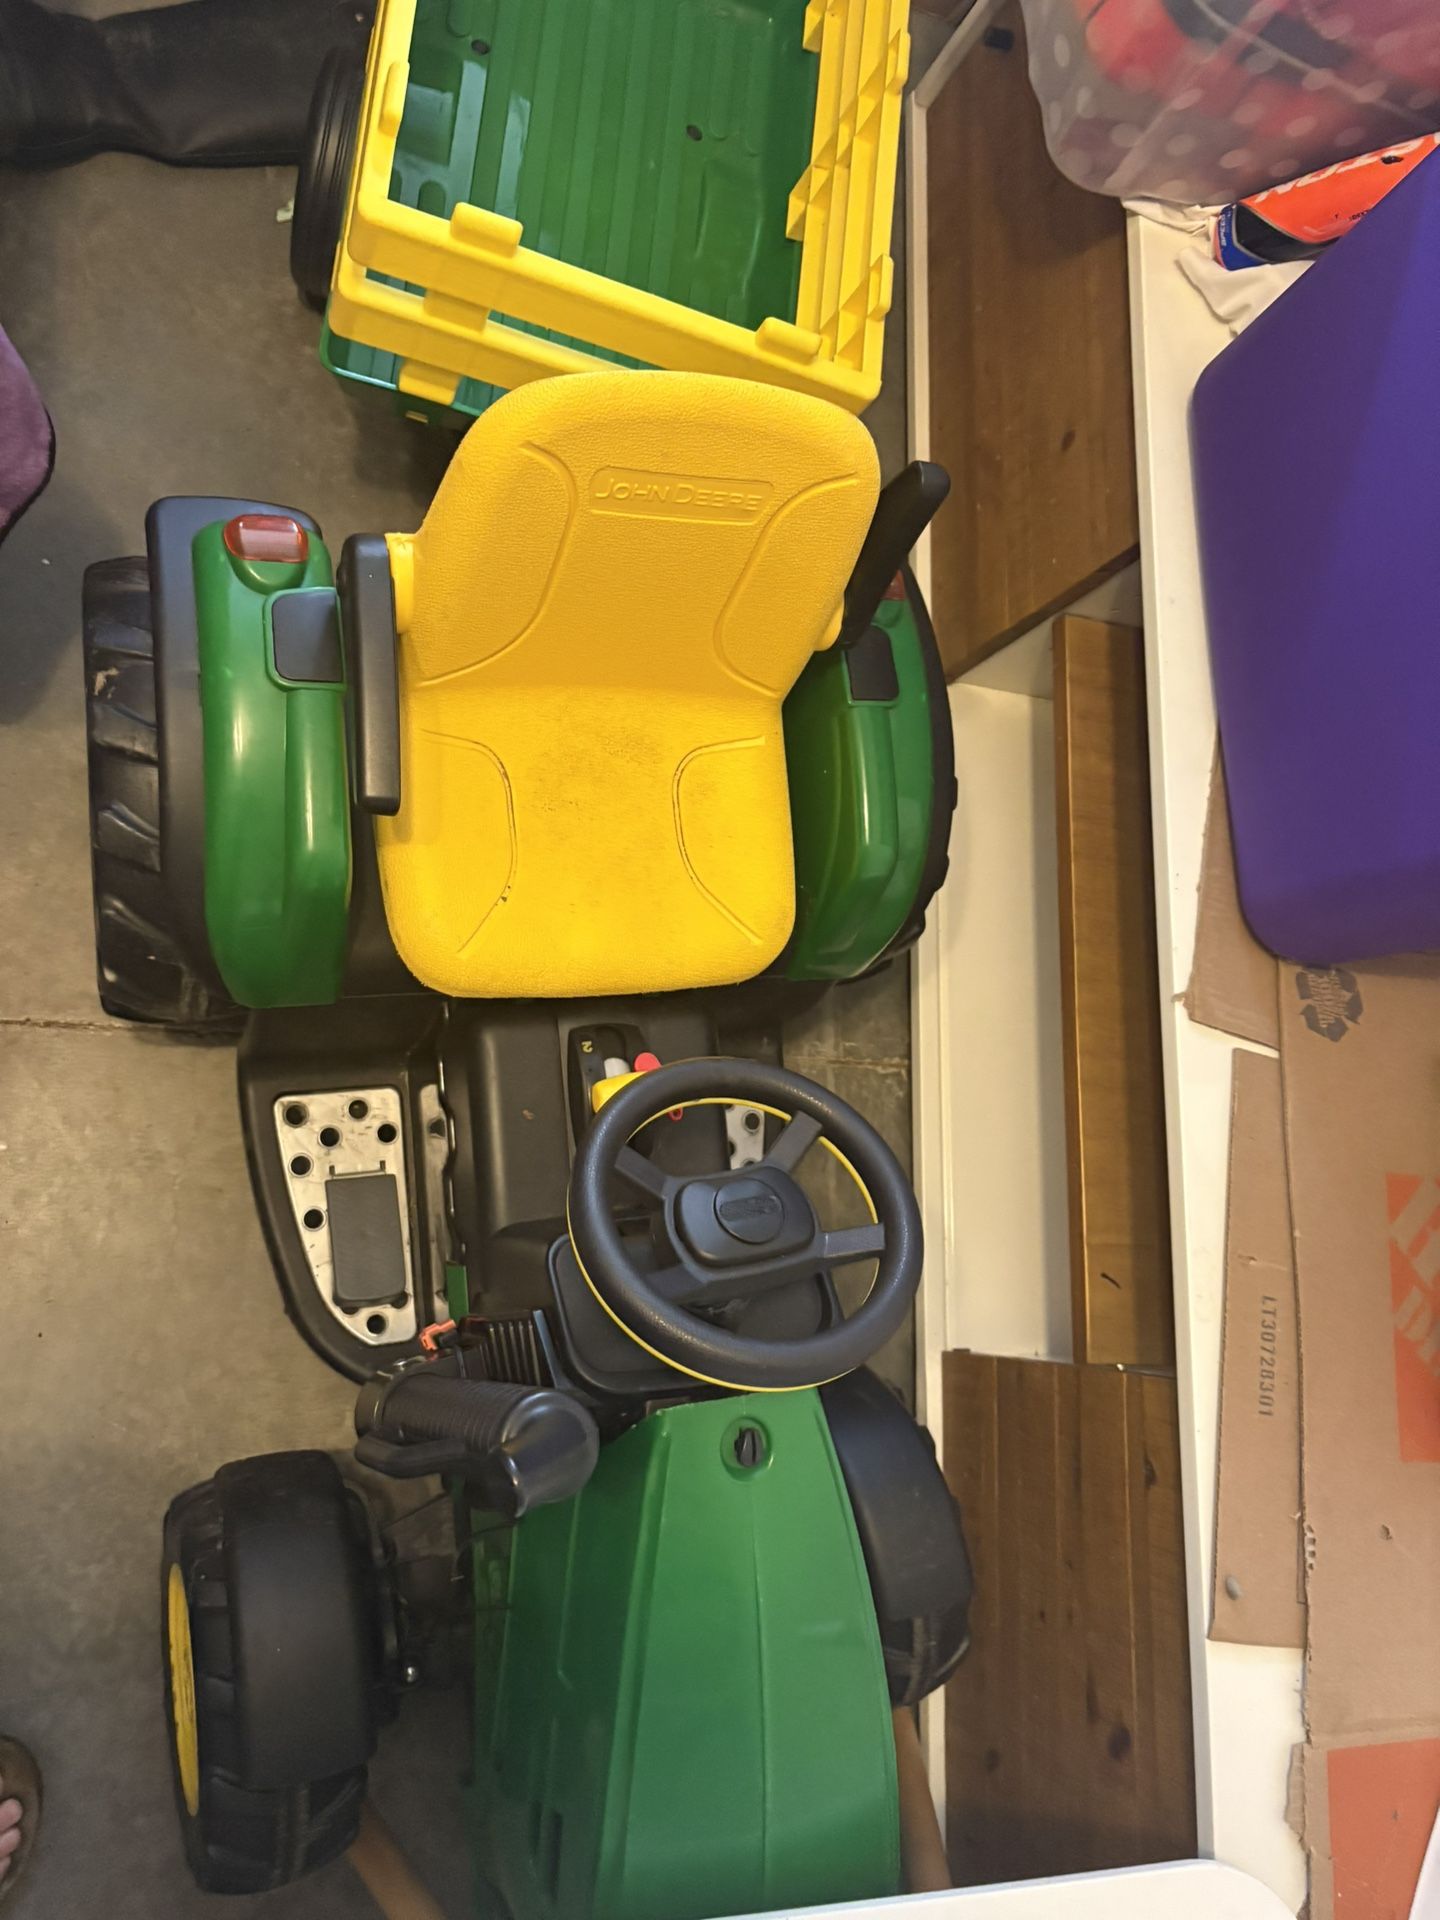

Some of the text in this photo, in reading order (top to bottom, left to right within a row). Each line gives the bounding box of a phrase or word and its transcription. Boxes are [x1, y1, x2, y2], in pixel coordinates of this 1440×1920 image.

[595, 477, 763, 511] JOHN DEERE
[581, 1040, 594, 1054] 2
